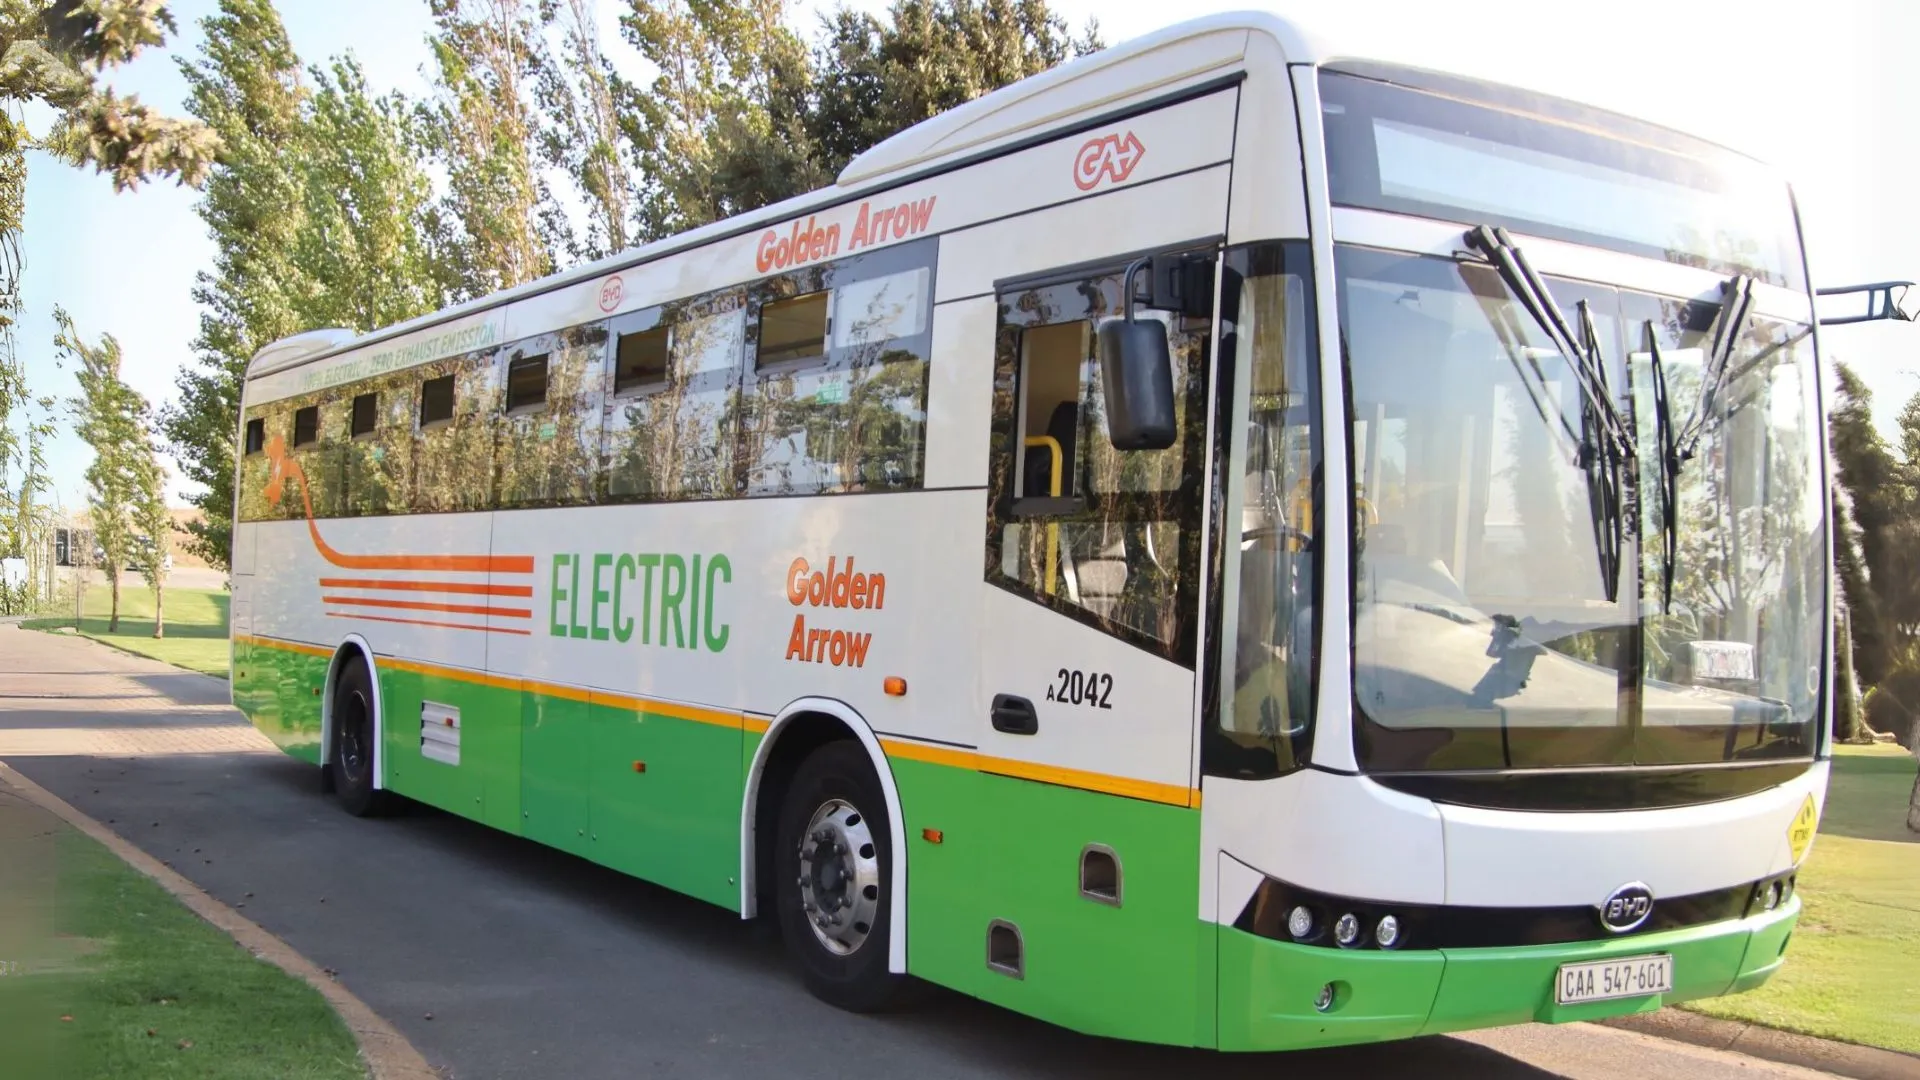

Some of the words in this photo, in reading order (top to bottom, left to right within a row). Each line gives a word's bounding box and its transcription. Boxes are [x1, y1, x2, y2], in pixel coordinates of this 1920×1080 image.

[756, 216, 840, 273] Golden
[848, 196, 937, 250] Arrow
[370, 351, 393, 374] ZERO
[395, 337, 439, 367] EXHAUST
[441, 322, 497, 354] EMISSION
[550, 553, 732, 652] ELECTRIC
[787, 555, 886, 610] Golden
[785, 613, 872, 668] Arrow
[1607, 896, 1649, 918] BYD
[1565, 968, 1595, 998] CAA
